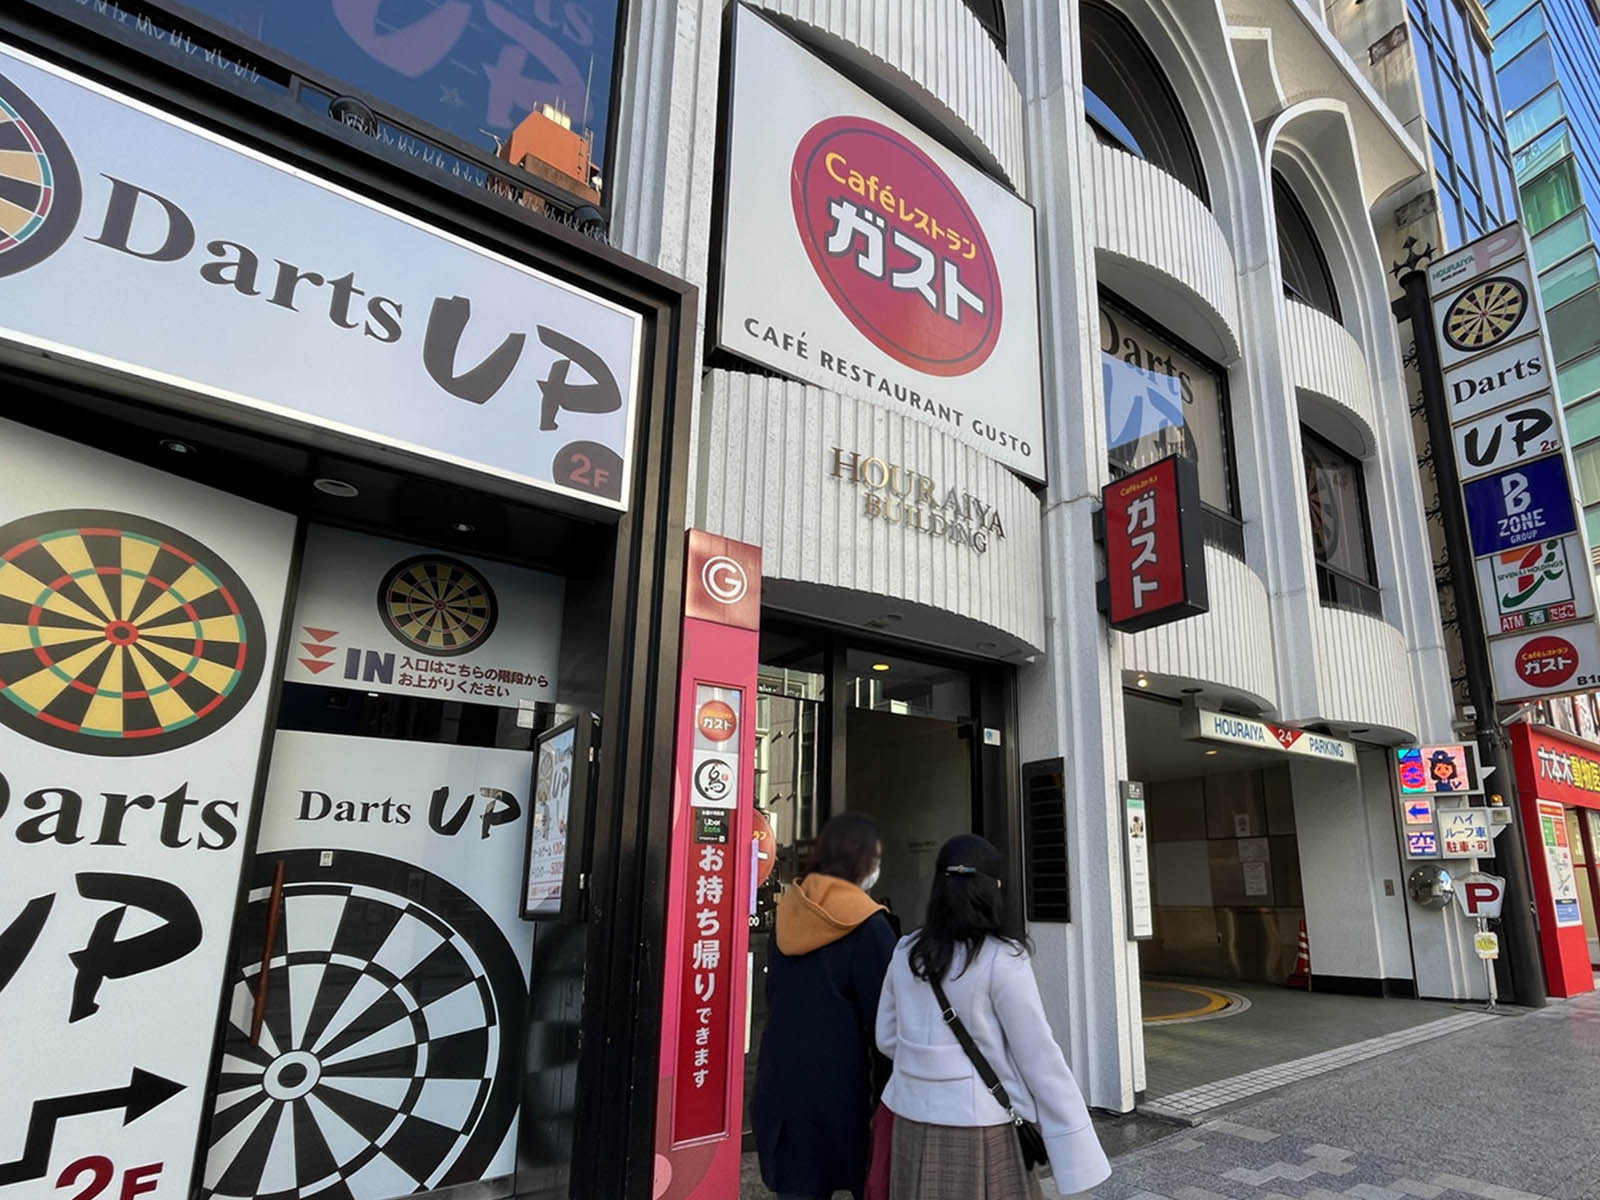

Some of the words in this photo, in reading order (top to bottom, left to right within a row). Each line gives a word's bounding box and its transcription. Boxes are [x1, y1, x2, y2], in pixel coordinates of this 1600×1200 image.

[825, 152, 976, 259] Caféレストラン
[828, 201, 983, 320] ガスト
[84, 172, 403, 343] Darts
[423, 295, 622, 431] UP
[744, 318, 808, 359] CAFÉ
[820, 351, 963, 426] RESTAURANT
[972, 419, 1031, 457] GUSTO
[1453, 357, 1541, 405] Darts
[1464, 408, 1553, 467] UP
[1540, 440, 1558, 452] 2F
[569, 454, 609, 487] 2F
[830, 447, 1005, 540] HOURAIYA
[1501, 472, 1531, 517] B
[864, 492, 987, 554] BUILDING
[1497, 508, 1546, 537] ZONE
[1510, 530, 1538, 544] GROUP
[1127, 490, 1158, 608] ガスト
[709, 563, 741, 598] G
[1502, 614, 1525, 631] ATM
[344, 647, 396, 685] IN
[400, 656, 549, 688] 入口はこちらの階段から
[1525, 657, 1572, 675] ガスト
[398, 673, 510, 697] お上がりください
[703, 717, 732, 730] ガスト
[1214, 717, 1265, 742] HOURAIYA
[1278, 729, 1293, 743] 24
[1309, 737, 1344, 757] PARKING
[295, 789, 411, 824] Darts
[428, 786, 521, 840] UP
[704, 818, 721, 826] Uber
[1453, 813, 1473, 824] ハイ
[1408, 833, 1436, 855] 空
[1445, 826, 1486, 838] ルーフ車
[1465, 883, 1499, 913] P
[692, 844, 725, 1089] お持ち帰りできます
[56, 1155, 164, 1200] 2F
